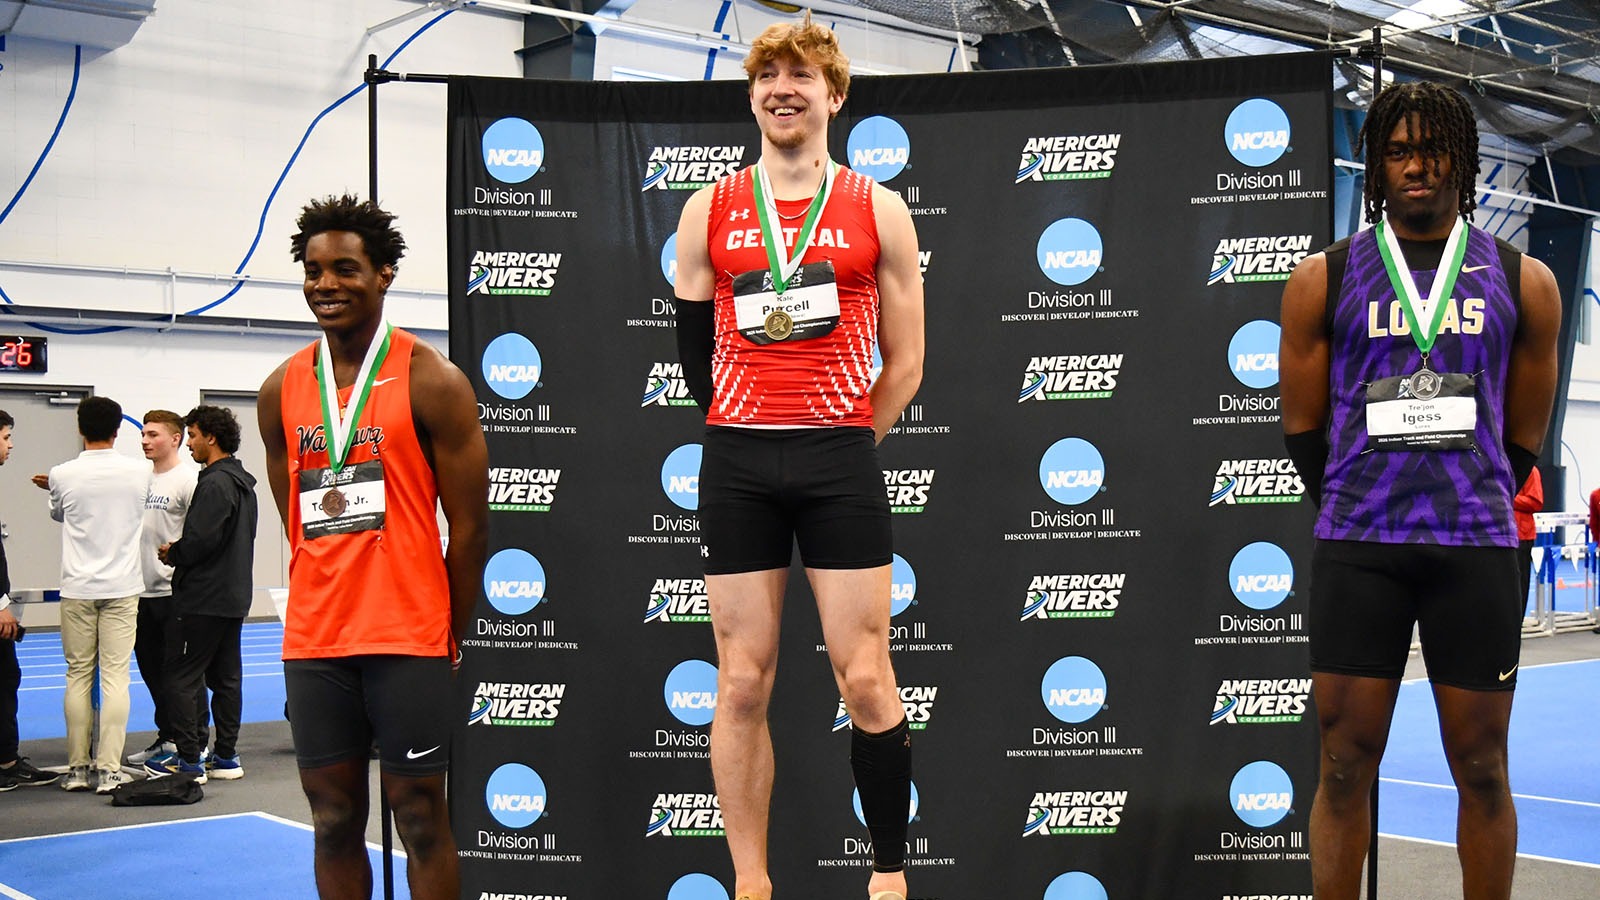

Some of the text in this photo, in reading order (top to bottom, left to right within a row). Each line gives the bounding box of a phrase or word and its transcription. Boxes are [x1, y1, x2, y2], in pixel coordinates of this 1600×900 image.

[1023, 134, 1121, 152] AMERICAN
[1232, 130, 1287, 150] NCAA
[487, 149, 542, 167] NCAA
[650, 146, 745, 161] AMERICAN
[854, 148, 908, 166] NCAA
[1015, 150, 1116, 184] RIVERS
[1217, 170, 1300, 191] Division III
[475, 187, 551, 206] Division III
[908, 187, 919, 202] III
[1191, 191, 1327, 204] DISCOVER DEVELOP DEDICATE
[454, 208, 490, 216] DISCOVER
[493, 209, 530, 217] DEVELOP
[1215, 235, 1312, 254] AMERICAN
[472, 251, 561, 268] AMERICAN
[1044, 250, 1099, 269] NCAA
[467, 266, 557, 296] RIVERS
[1028, 290, 1111, 309] Division III
[1001, 310, 1139, 322] DISCOVER DEVELOP DEDICATE
[1368, 298, 1485, 338] LOAS
[1, 343, 33, 366] 26
[1026, 354, 1123, 371] AMERICAN
[1235, 354, 1278, 371] NCA
[489, 366, 539, 382] NCAA
[1018, 370, 1119, 403] RIVERS
[538, 405, 550, 421] III
[911, 405, 923, 421] III
[1193, 417, 1235, 425] DISCOVER
[1403, 413, 1441, 425] Igess
[906, 426, 950, 434] DEDICATE
[1217, 459, 1297, 475] AMERICA
[489, 468, 561, 484] MERICAN
[1047, 470, 1101, 488] NCAA
[669, 477, 699, 493] NC
[1209, 475, 1305, 507] RIVERS
[354, 496, 368, 505] Jr.
[489, 484, 555, 504] IVERS
[1031, 509, 1113, 528] Division III
[629, 536, 669, 544] DISCOVER
[1004, 533, 1047, 541] DISCOVER
[1098, 530, 1141, 538] DEDICATE
[490, 581, 543, 598] NCAA
[1029, 574, 1126, 590] AMERICAN
[1236, 574, 1291, 592] NCAA
[644, 594, 711, 623] RIVE
[1020, 590, 1121, 622] RIVERS
[477, 619, 554, 636] Division III
[914, 623, 925, 639] III
[1220, 614, 1302, 632] Division III
[1195, 637, 1236, 645] DISCOVER
[1242, 636, 1281, 644] DEVELOP
[476, 682, 565, 698] AMERICAN
[1217, 679, 1312, 695] AMERICAN
[1049, 689, 1105, 706] NCAA
[468, 697, 561, 726] RIVERS
[1210, 695, 1308, 725] RIVERS
[656, 730, 711, 747] Divisio
[1033, 727, 1116, 745] Division III
[630, 751, 672, 759] DISCOVER
[492, 794, 543, 812] NCAA
[653, 794, 720, 808] AMERIC
[1031, 791, 1127, 807] AMERICAN
[1237, 793, 1290, 810] NCAA
[646, 809, 725, 837] RIVER
[1023, 807, 1122, 837] RIVERS
[478, 831, 555, 849] Division III
[917, 839, 928, 854] III
[1221, 832, 1302, 849] Division III
[498, 853, 534, 861] DEVELOP
[912, 858, 955, 866] DEDICATE
